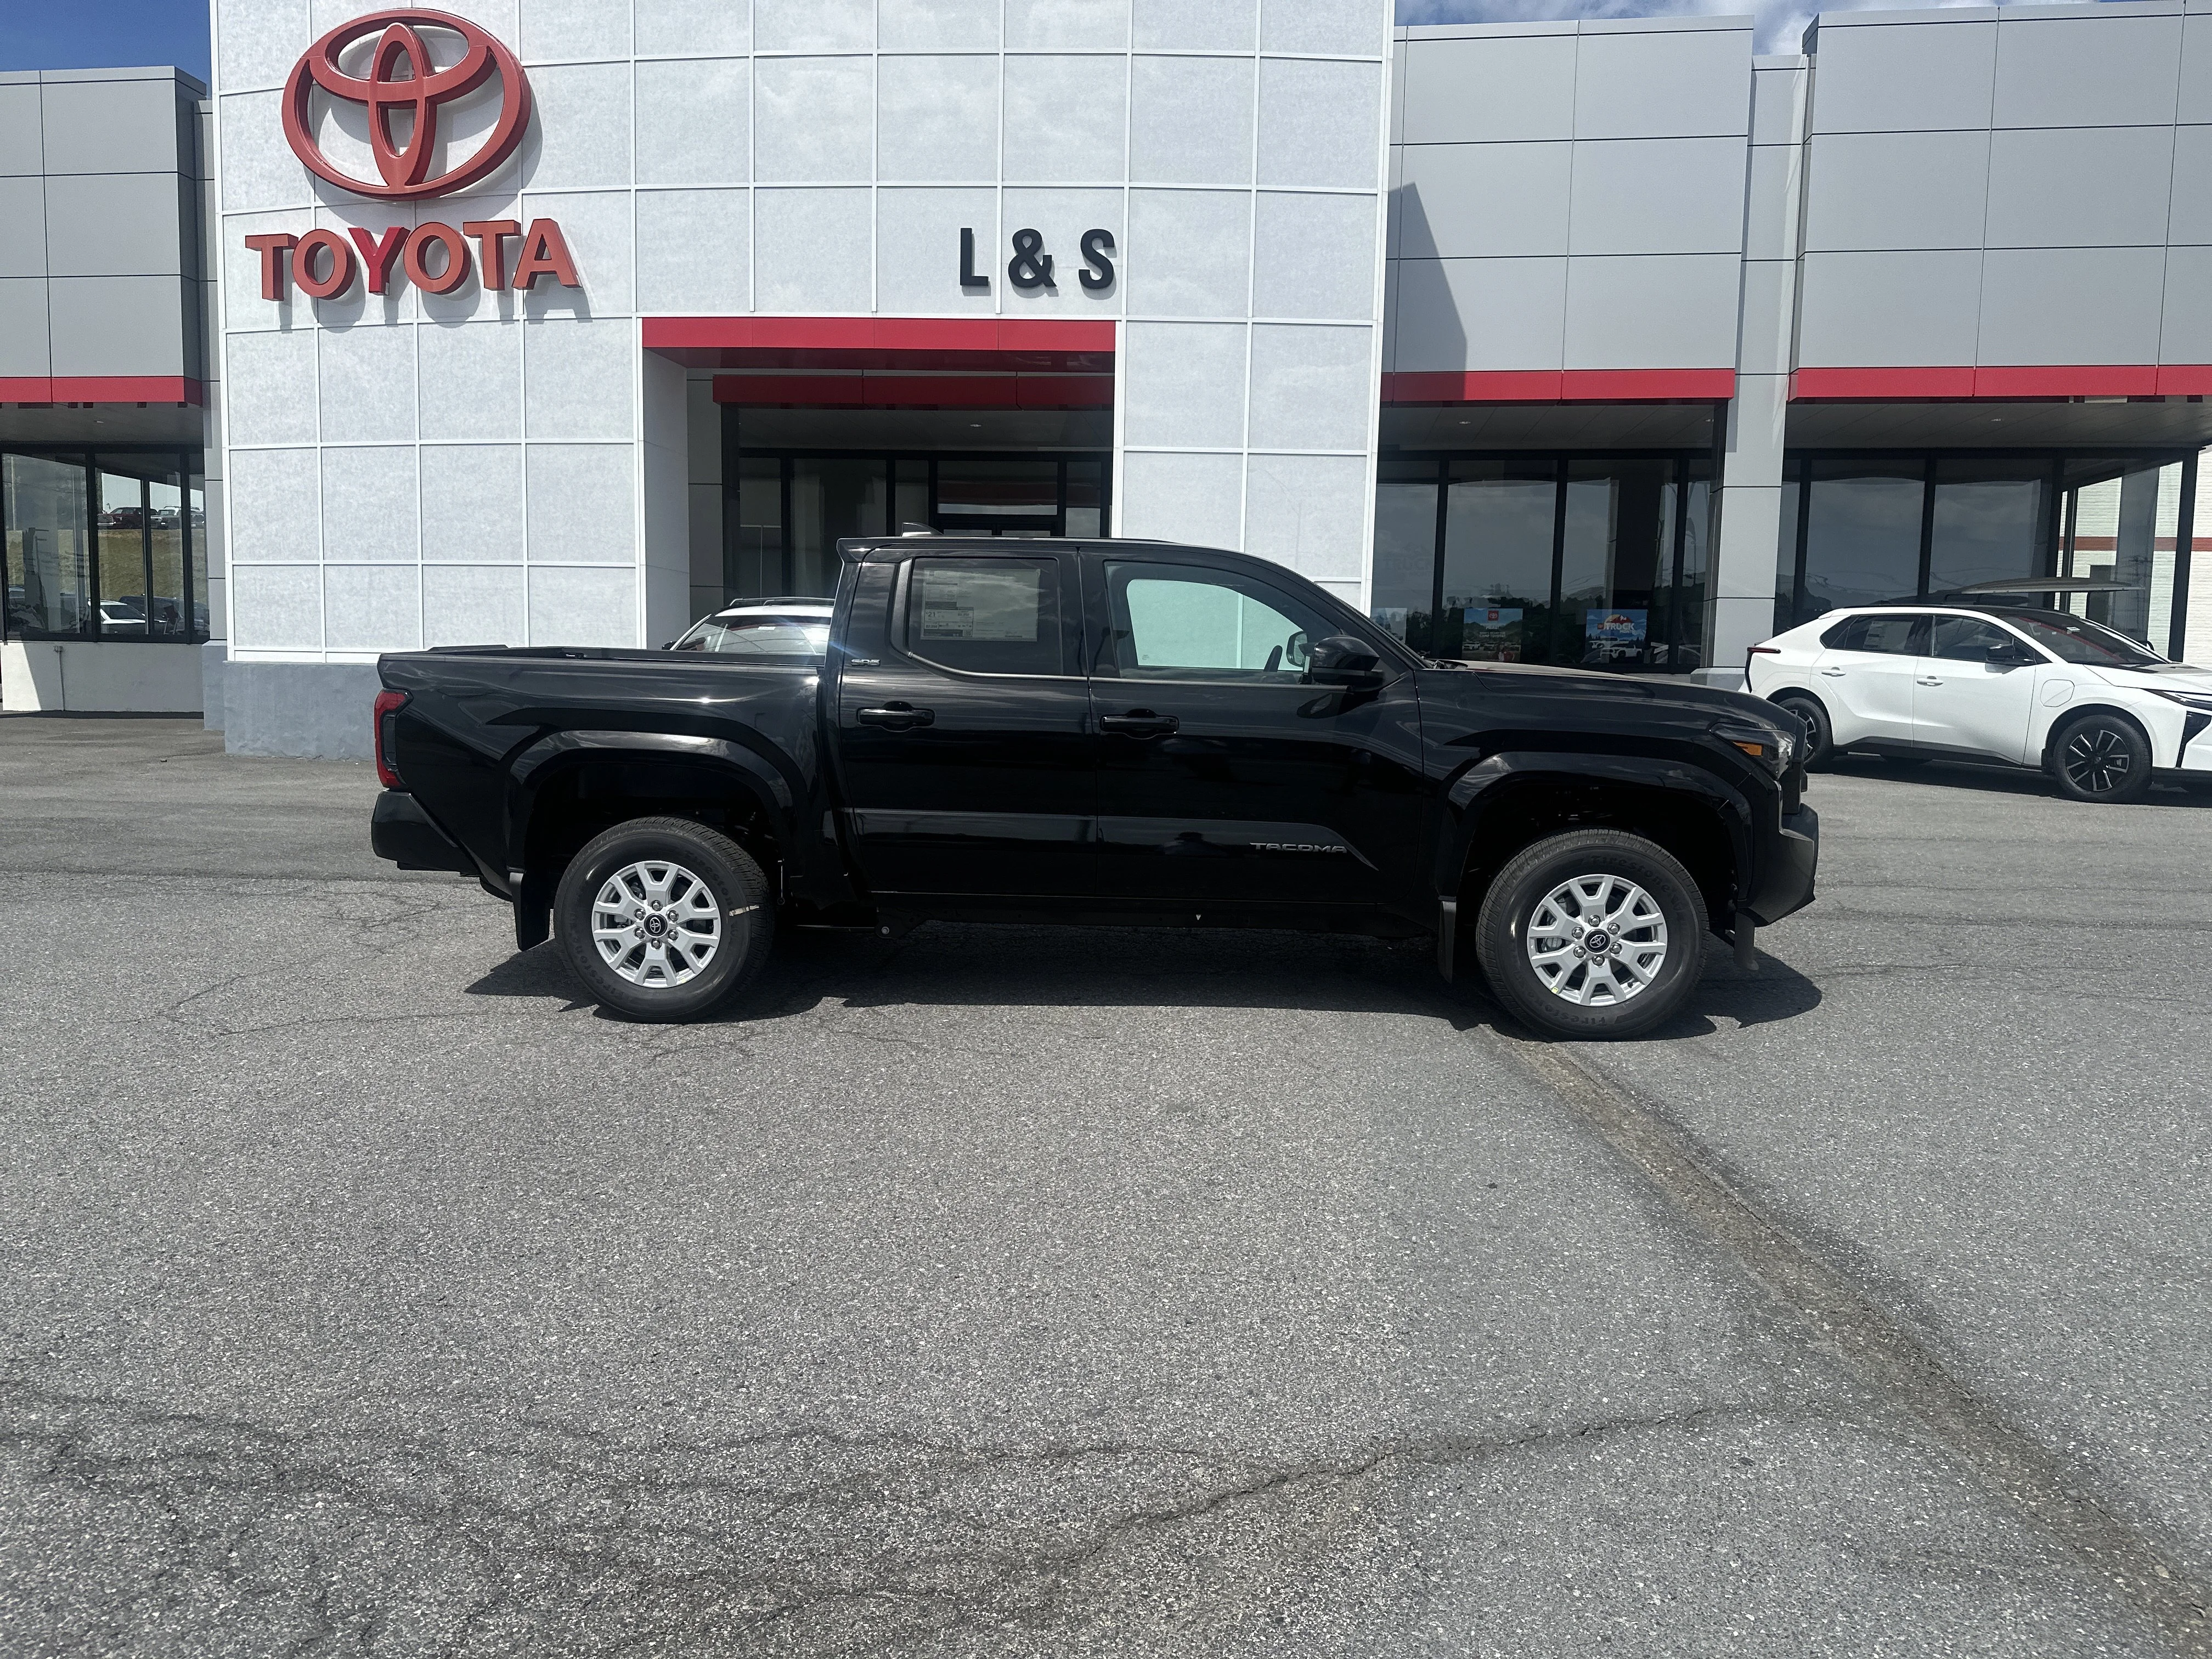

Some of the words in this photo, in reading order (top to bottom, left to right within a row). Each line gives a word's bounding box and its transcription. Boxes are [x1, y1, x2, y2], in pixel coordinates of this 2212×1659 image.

[245, 218, 583, 301] TOYOTA
[960, 228, 989, 286] L
[1008, 228, 1057, 288] &
[1079, 229, 1115, 289] S
[1605, 622, 1635, 630] TRUCK
[1250, 842, 1347, 853] TACOMA
[683, 850, 737, 914] Fireston
[1590, 855, 1671, 893] Firestone
